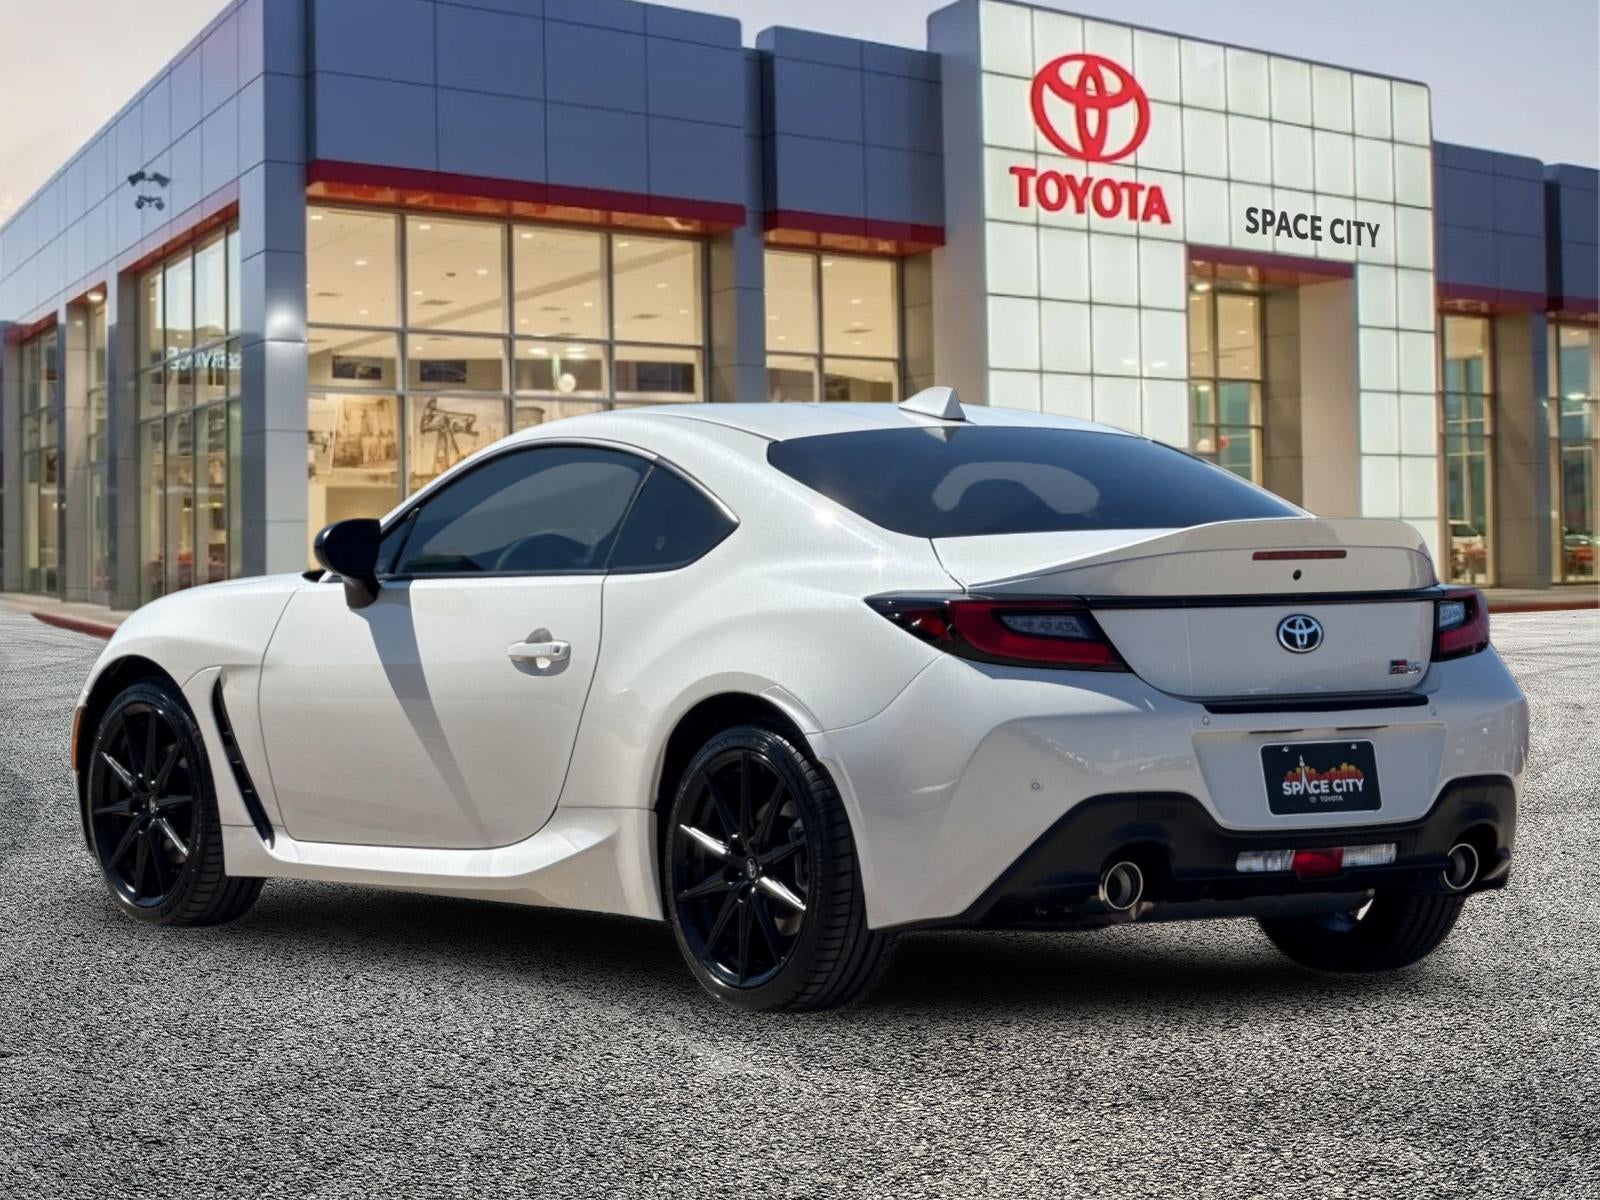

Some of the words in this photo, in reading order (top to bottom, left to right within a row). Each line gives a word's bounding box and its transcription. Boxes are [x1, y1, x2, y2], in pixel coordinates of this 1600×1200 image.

[1009, 166, 1171, 224] TOYOTA
[1245, 207, 1323, 241] SPACE
[1329, 217, 1380, 247] CITY
[1282, 779, 1330, 795] SPACE
[1333, 778, 1364, 792] CITY
